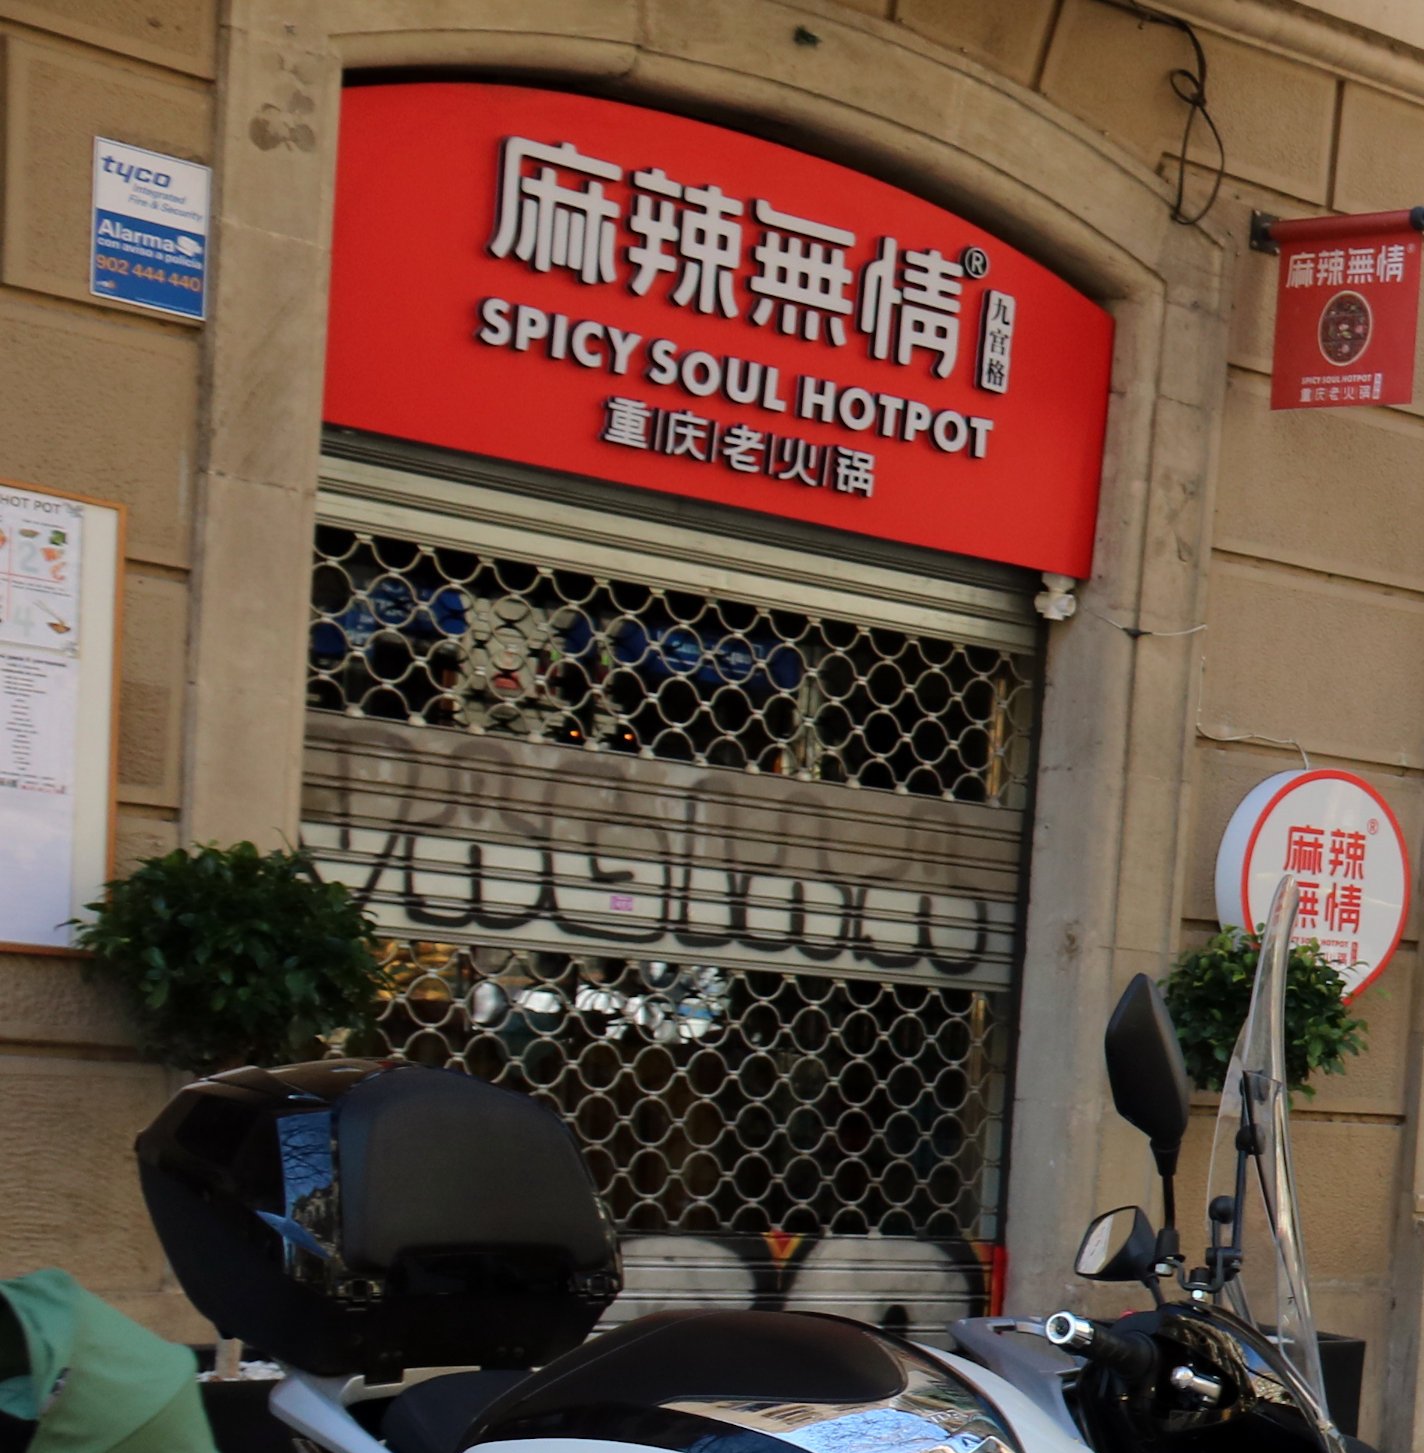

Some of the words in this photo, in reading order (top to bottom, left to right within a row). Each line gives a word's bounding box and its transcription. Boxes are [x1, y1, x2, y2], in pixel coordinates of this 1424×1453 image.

[101, 156, 171, 188] tyco
[128, 194, 148, 206] Fire
[150, 201, 159, 210] &
[161, 203, 203, 222] Security
[133, 184, 186, 204] Integrated
[97, 237, 120, 249] con
[122, 243, 153, 258] aviso
[155, 251, 163, 260] a
[98, 218, 175, 252] Alarma
[96, 254, 129, 275] 902
[132, 262, 167, 284] 444
[168, 271, 202, 293] 440
[490, 136, 966, 379] 麻辣無情
[1286, 243, 1405, 288] 麻辣無情
[478, 297, 643, 375] SPICY
[647, 338, 787, 413] SOUL
[799, 374, 995, 459] HOTPOT
[33, 499, 62, 514] POT
[1284, 825, 1366, 881] 麻辣
